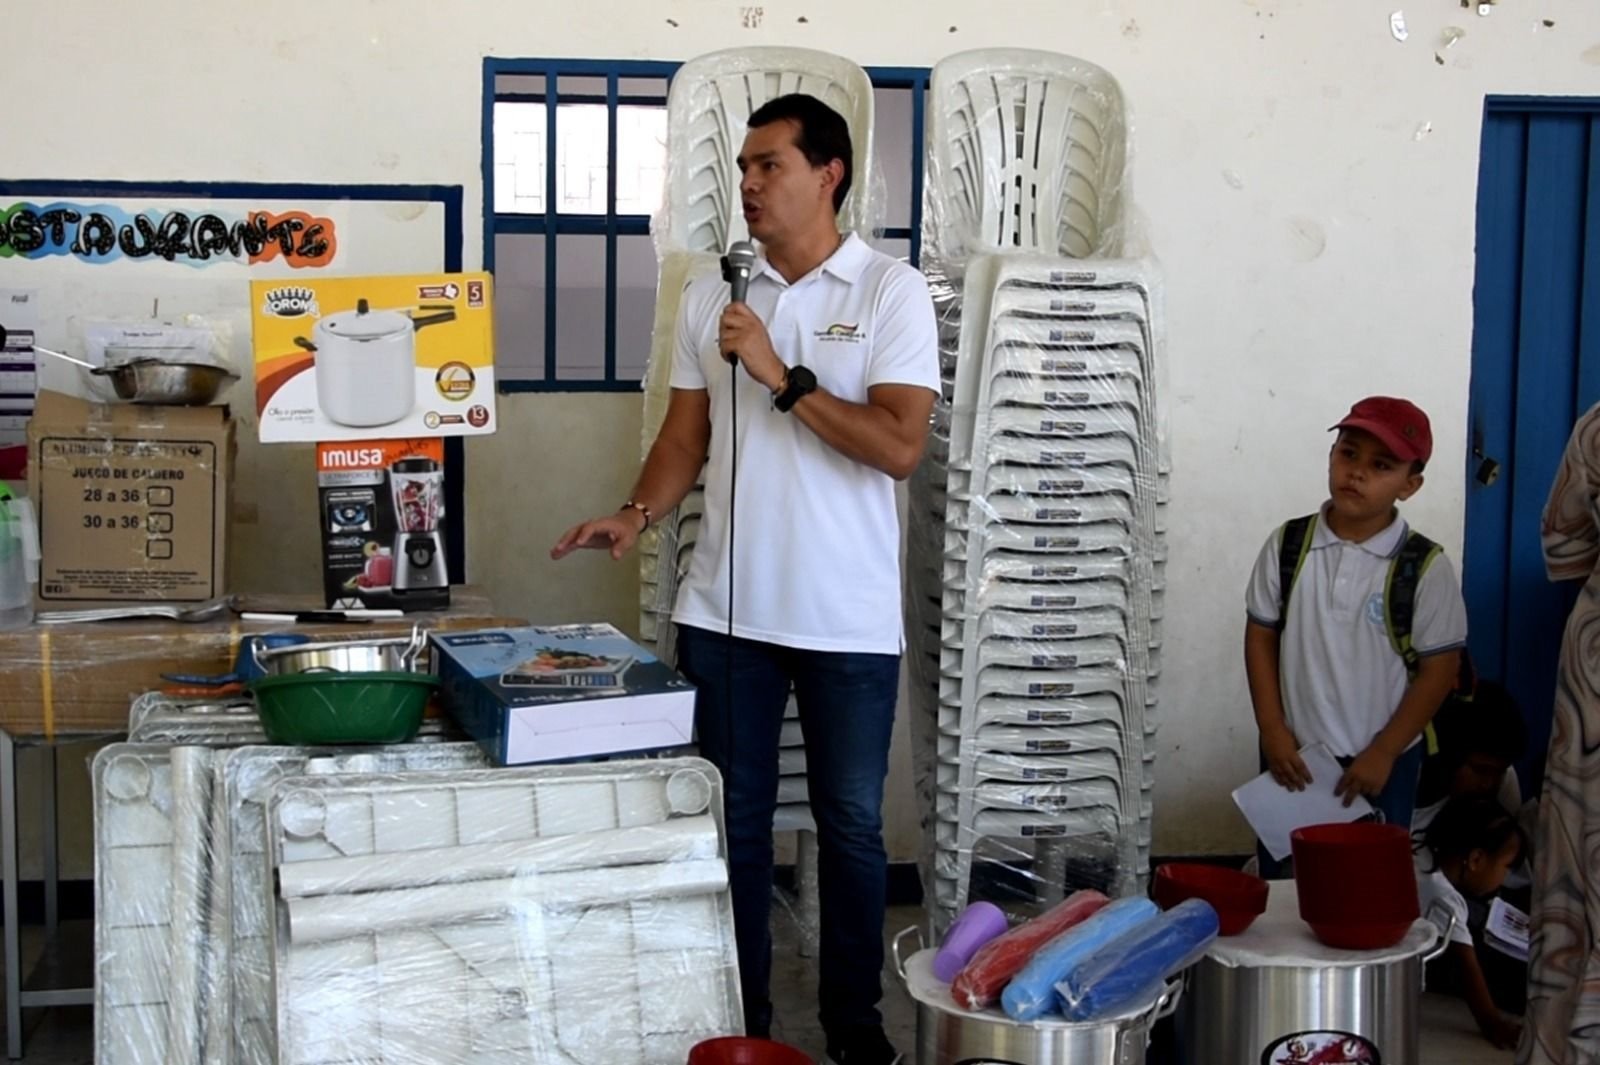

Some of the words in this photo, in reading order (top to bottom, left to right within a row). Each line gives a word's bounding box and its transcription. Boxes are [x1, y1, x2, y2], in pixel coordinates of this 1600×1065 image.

[0, 208, 329, 261] STAURANTE
[470, 286, 481, 300] 5
[113, 469, 129, 480] DE
[83, 489, 102, 502] 28
[107, 491, 117, 502] a
[121, 489, 140, 502] 36
[83, 515, 102, 528] 30
[107, 518, 117, 528] a
[121, 515, 140, 528] 36
